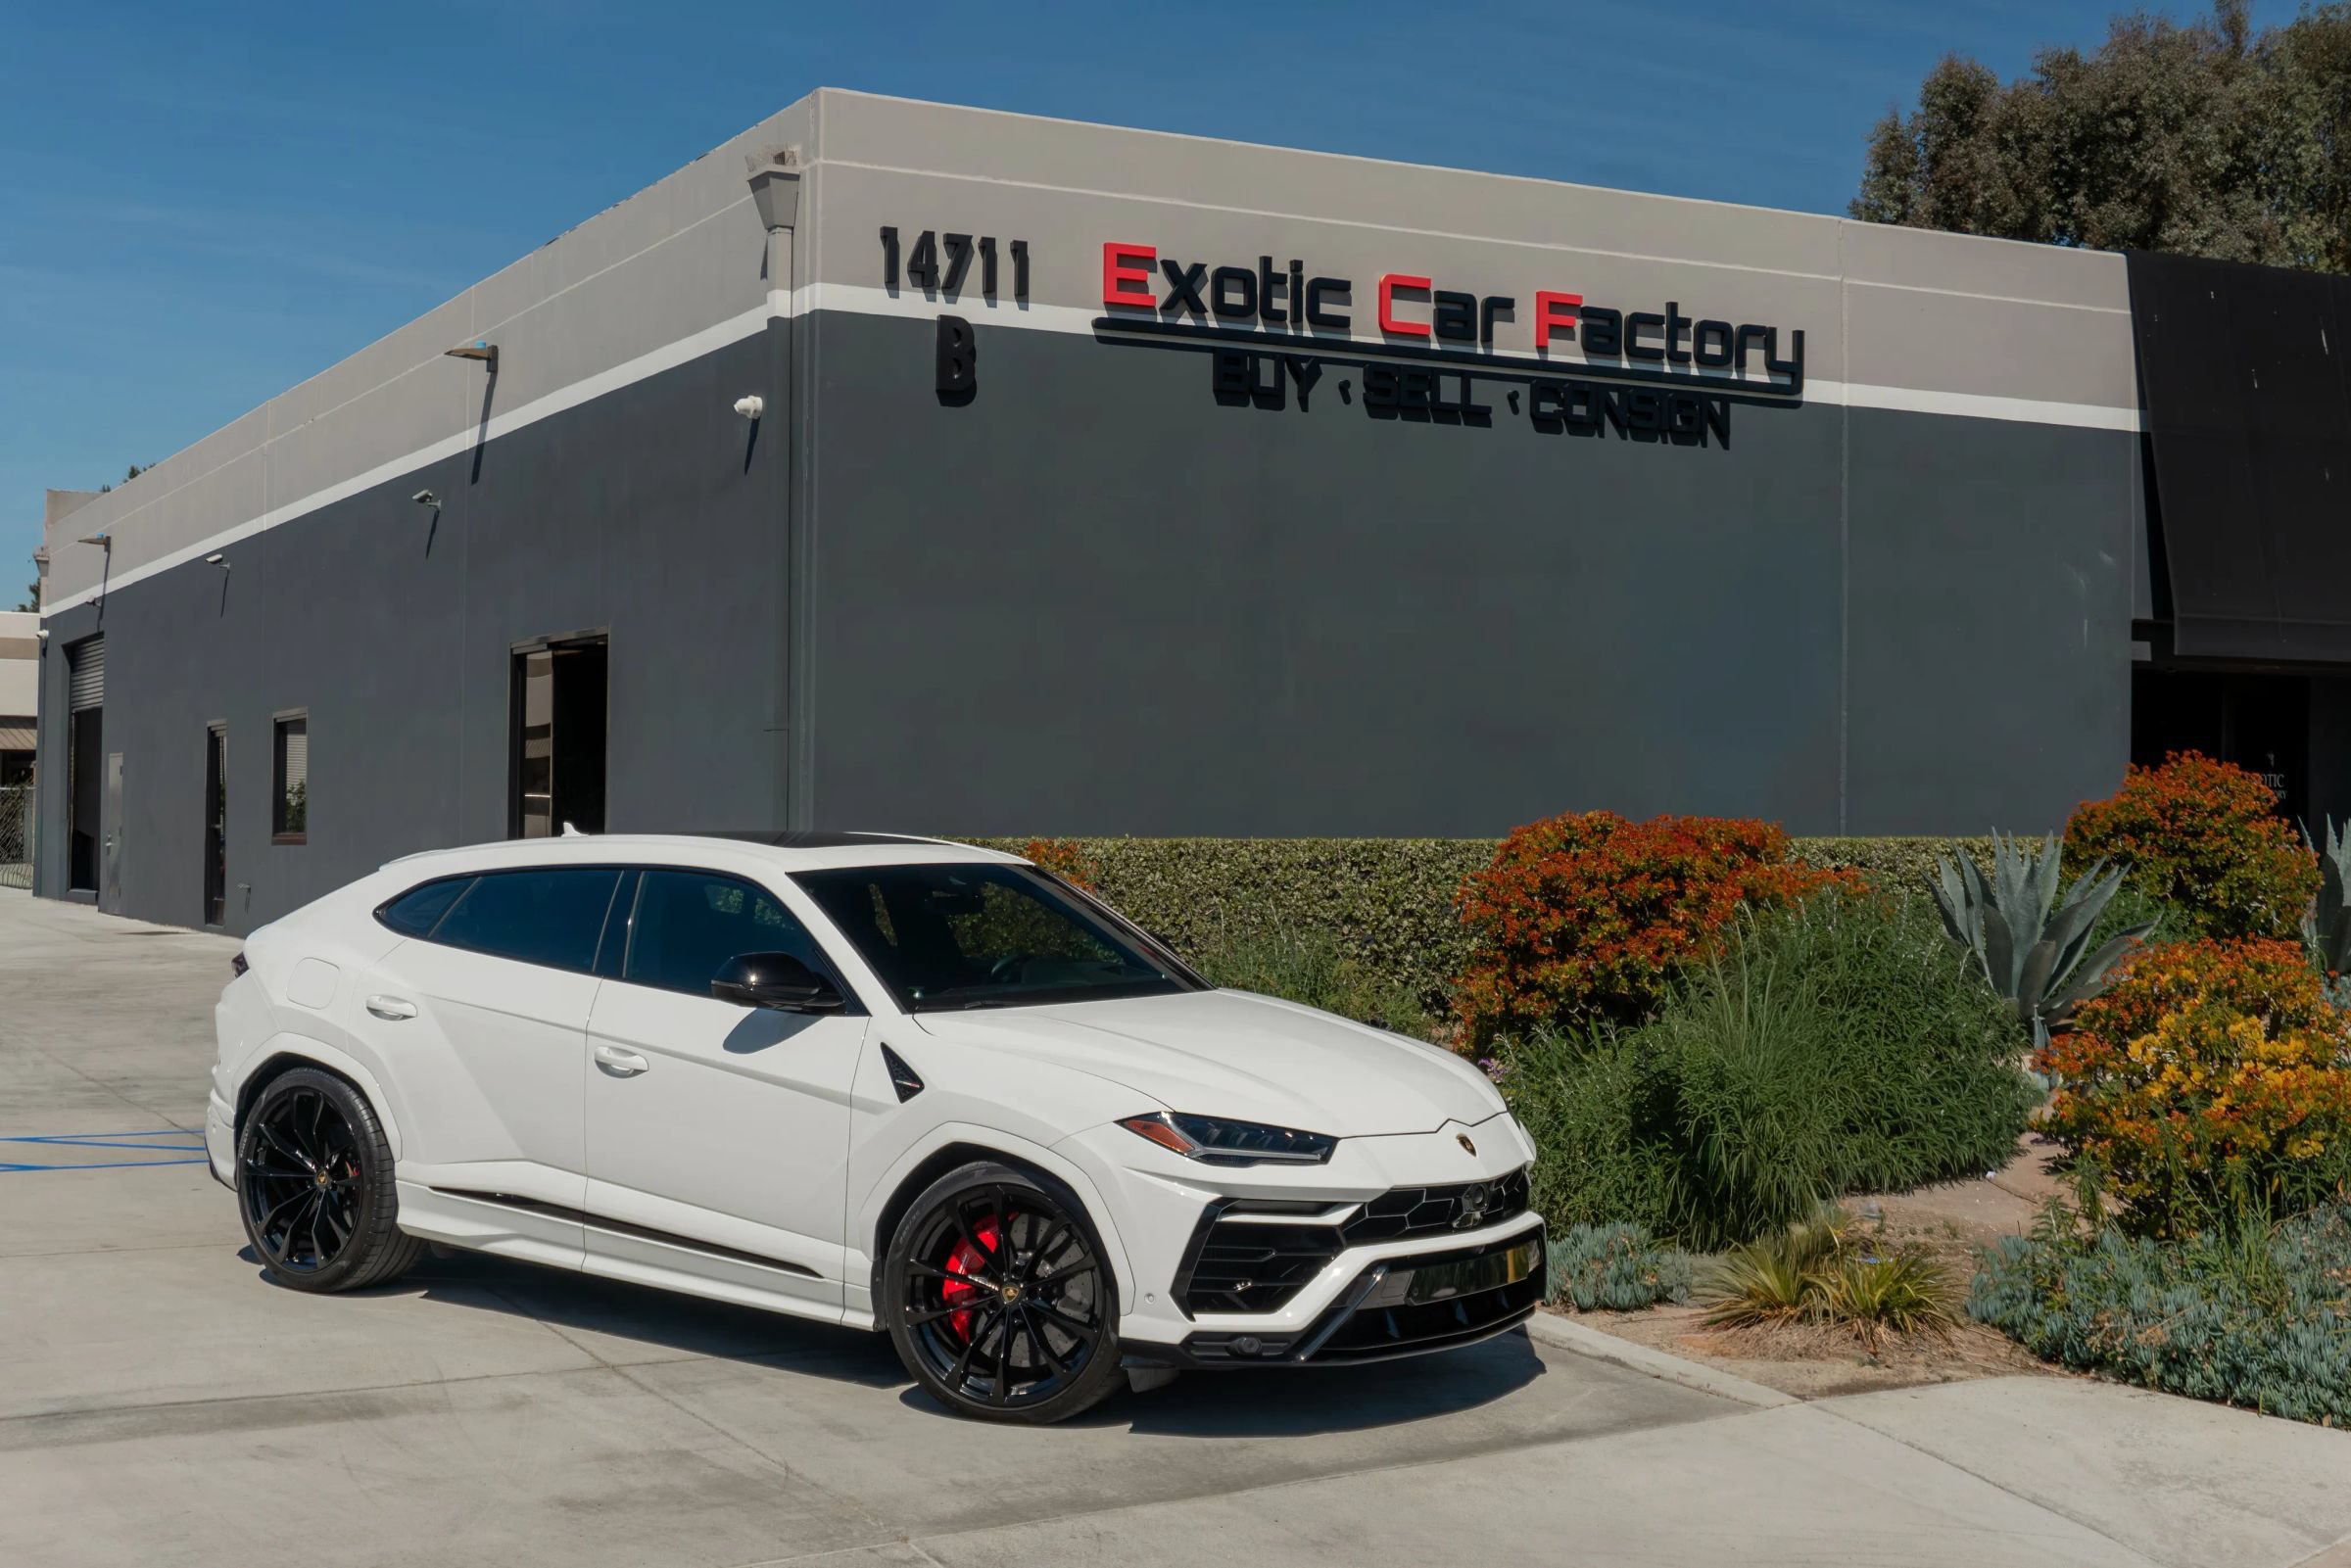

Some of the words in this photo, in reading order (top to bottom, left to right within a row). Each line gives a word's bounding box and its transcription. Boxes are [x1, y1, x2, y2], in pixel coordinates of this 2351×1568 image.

[880, 225, 1030, 297] 14711
[936, 313, 977, 394] B
[1102, 241, 1353, 328] Exotic
[1378, 273, 1515, 342] Car
[1535, 290, 1805, 396] Factory
[1213, 348, 1323, 400] BUY
[1363, 363, 1492, 415] SELL
[1530, 379, 1731, 440] CONSIGN
